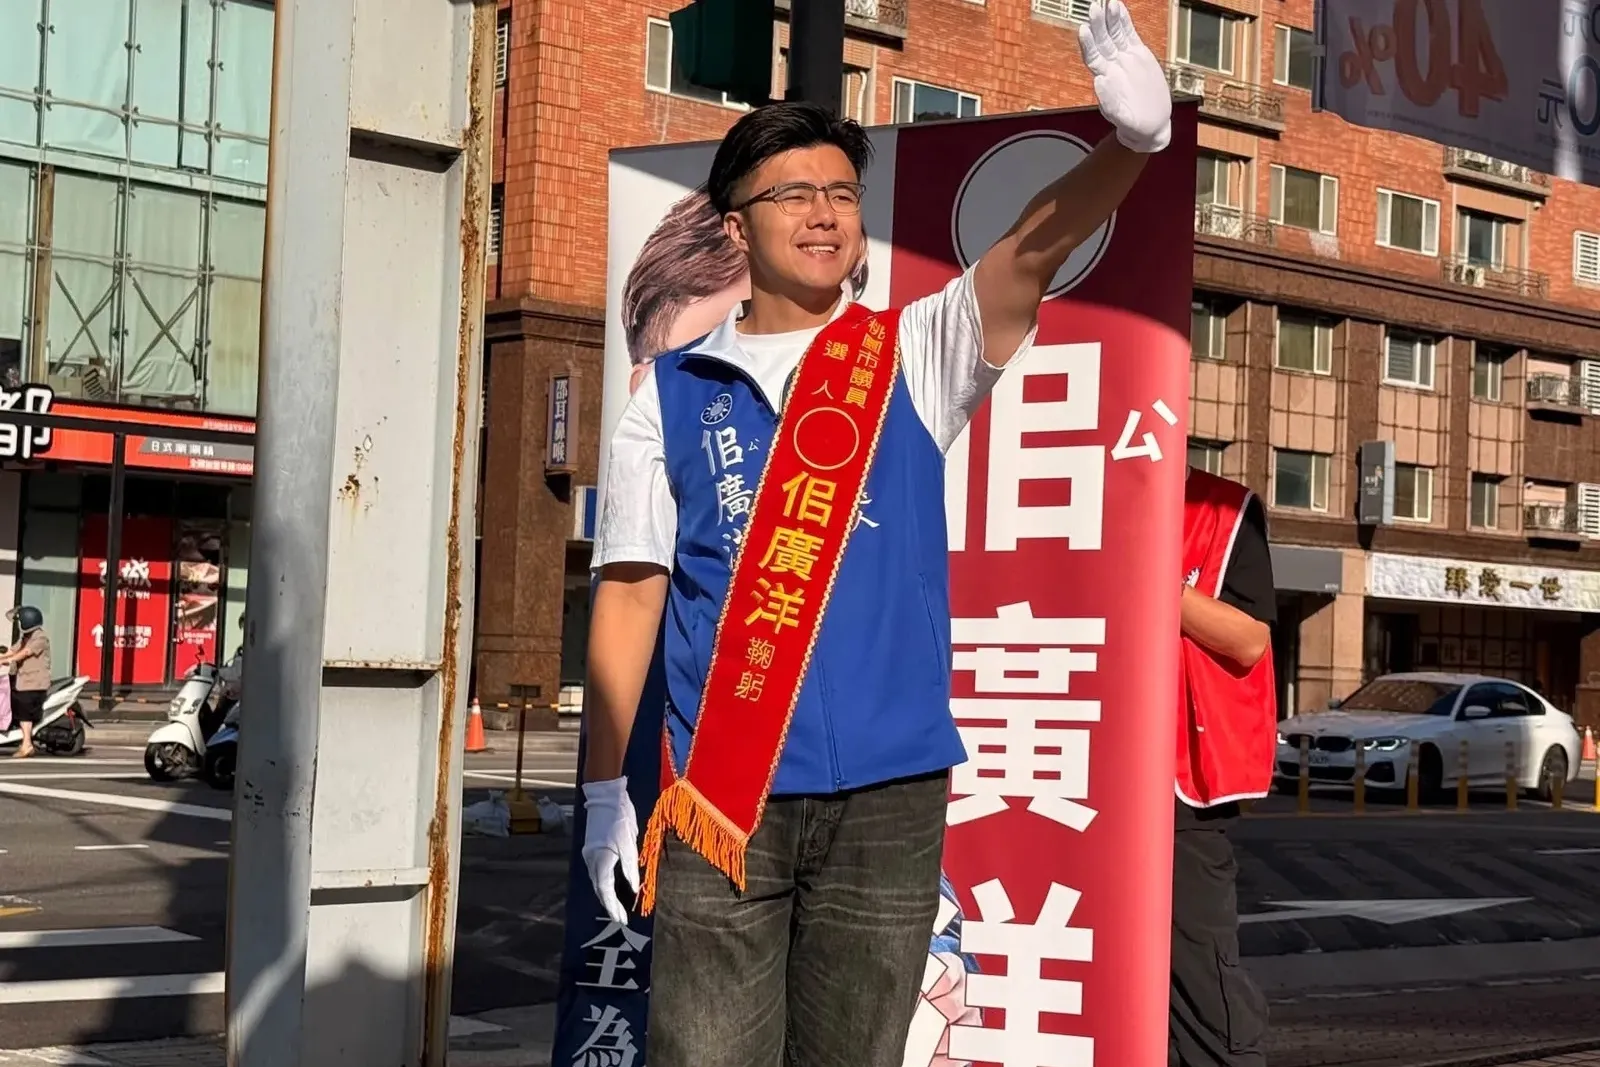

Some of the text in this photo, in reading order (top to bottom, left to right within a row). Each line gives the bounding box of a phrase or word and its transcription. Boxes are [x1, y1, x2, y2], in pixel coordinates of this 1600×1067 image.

[842, 318, 886, 410] 桃園市議員
[733, 636, 776, 702] 鞠躬
[572, 917, 652, 1067] 全為
